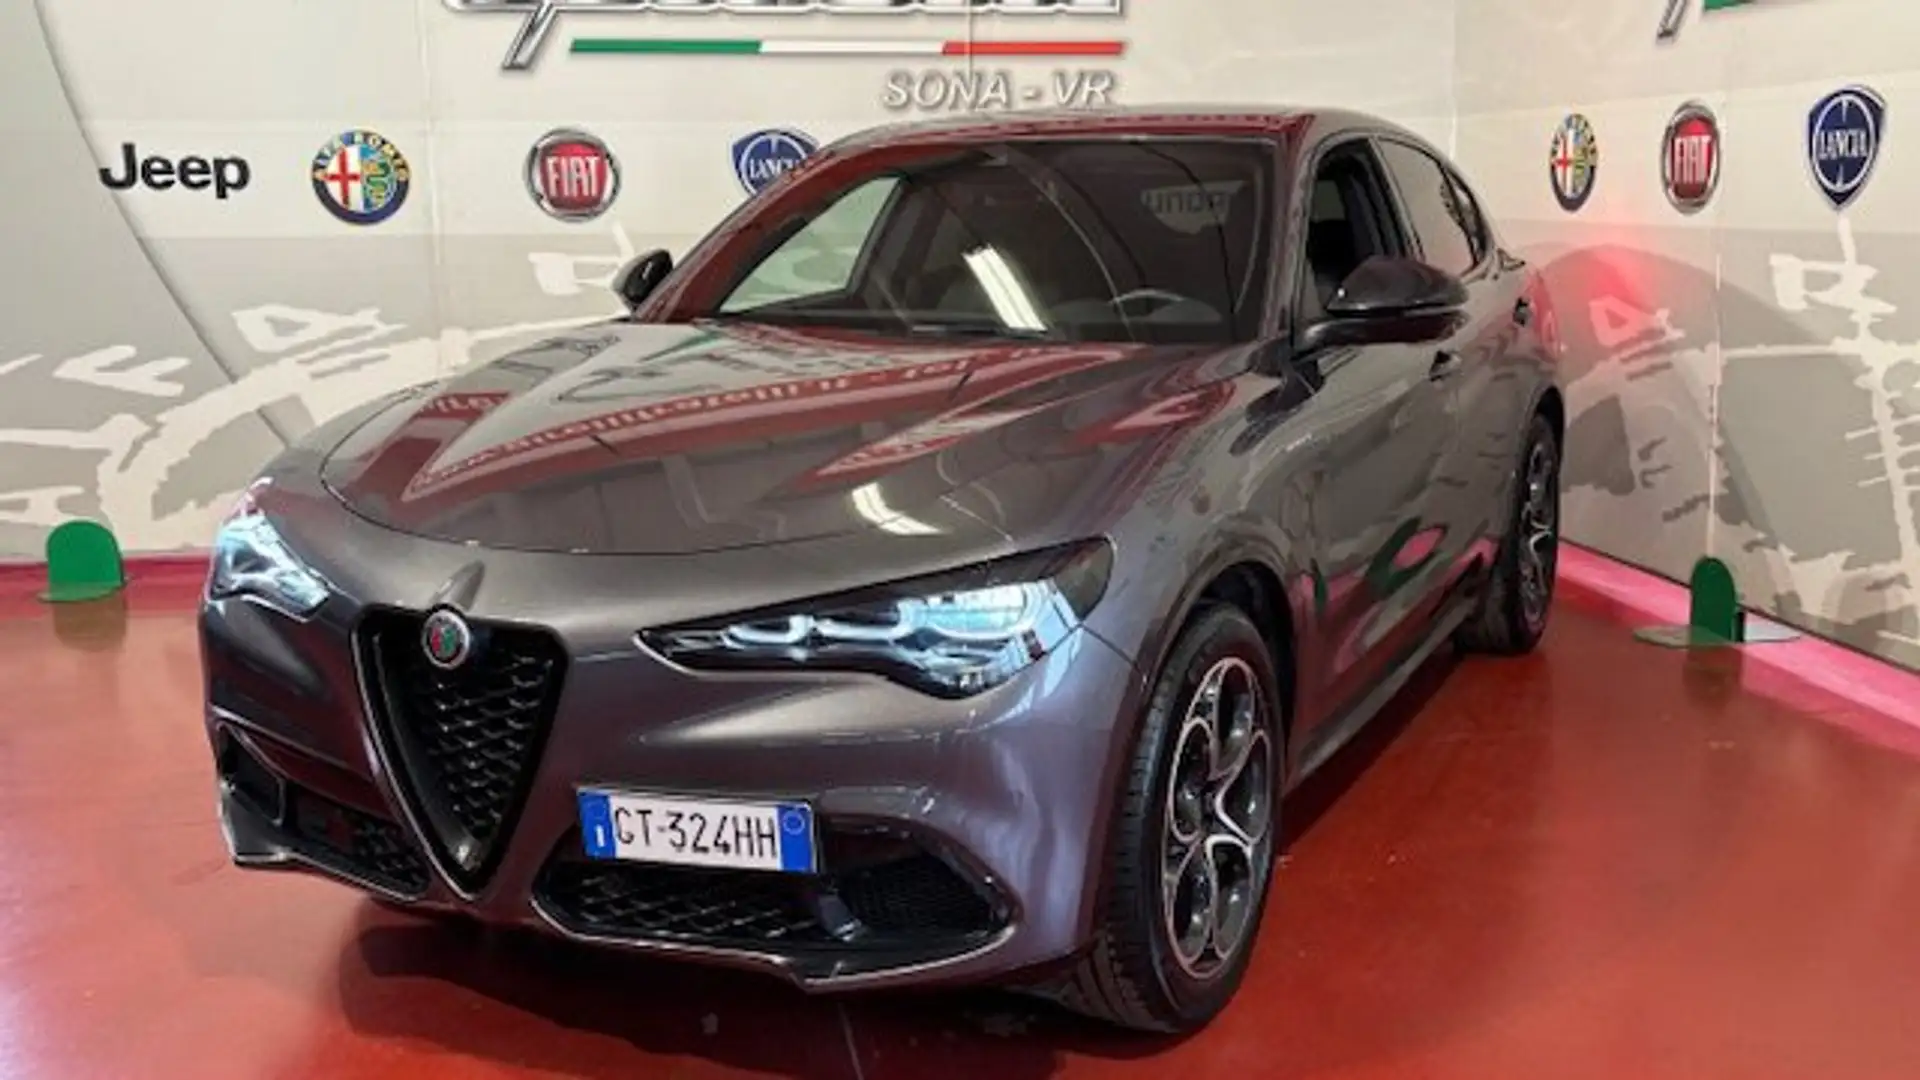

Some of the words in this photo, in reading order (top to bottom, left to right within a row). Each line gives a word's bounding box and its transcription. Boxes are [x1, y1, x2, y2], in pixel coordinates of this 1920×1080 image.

[883, 71, 1010, 108] SONA
[1053, 71, 1116, 105] VR
[1672, 133, 1710, 184] FIAT
[1816, 127, 1868, 160] LANCIA
[99, 142, 251, 199] Jeep
[546, 154, 603, 198] FIAT
